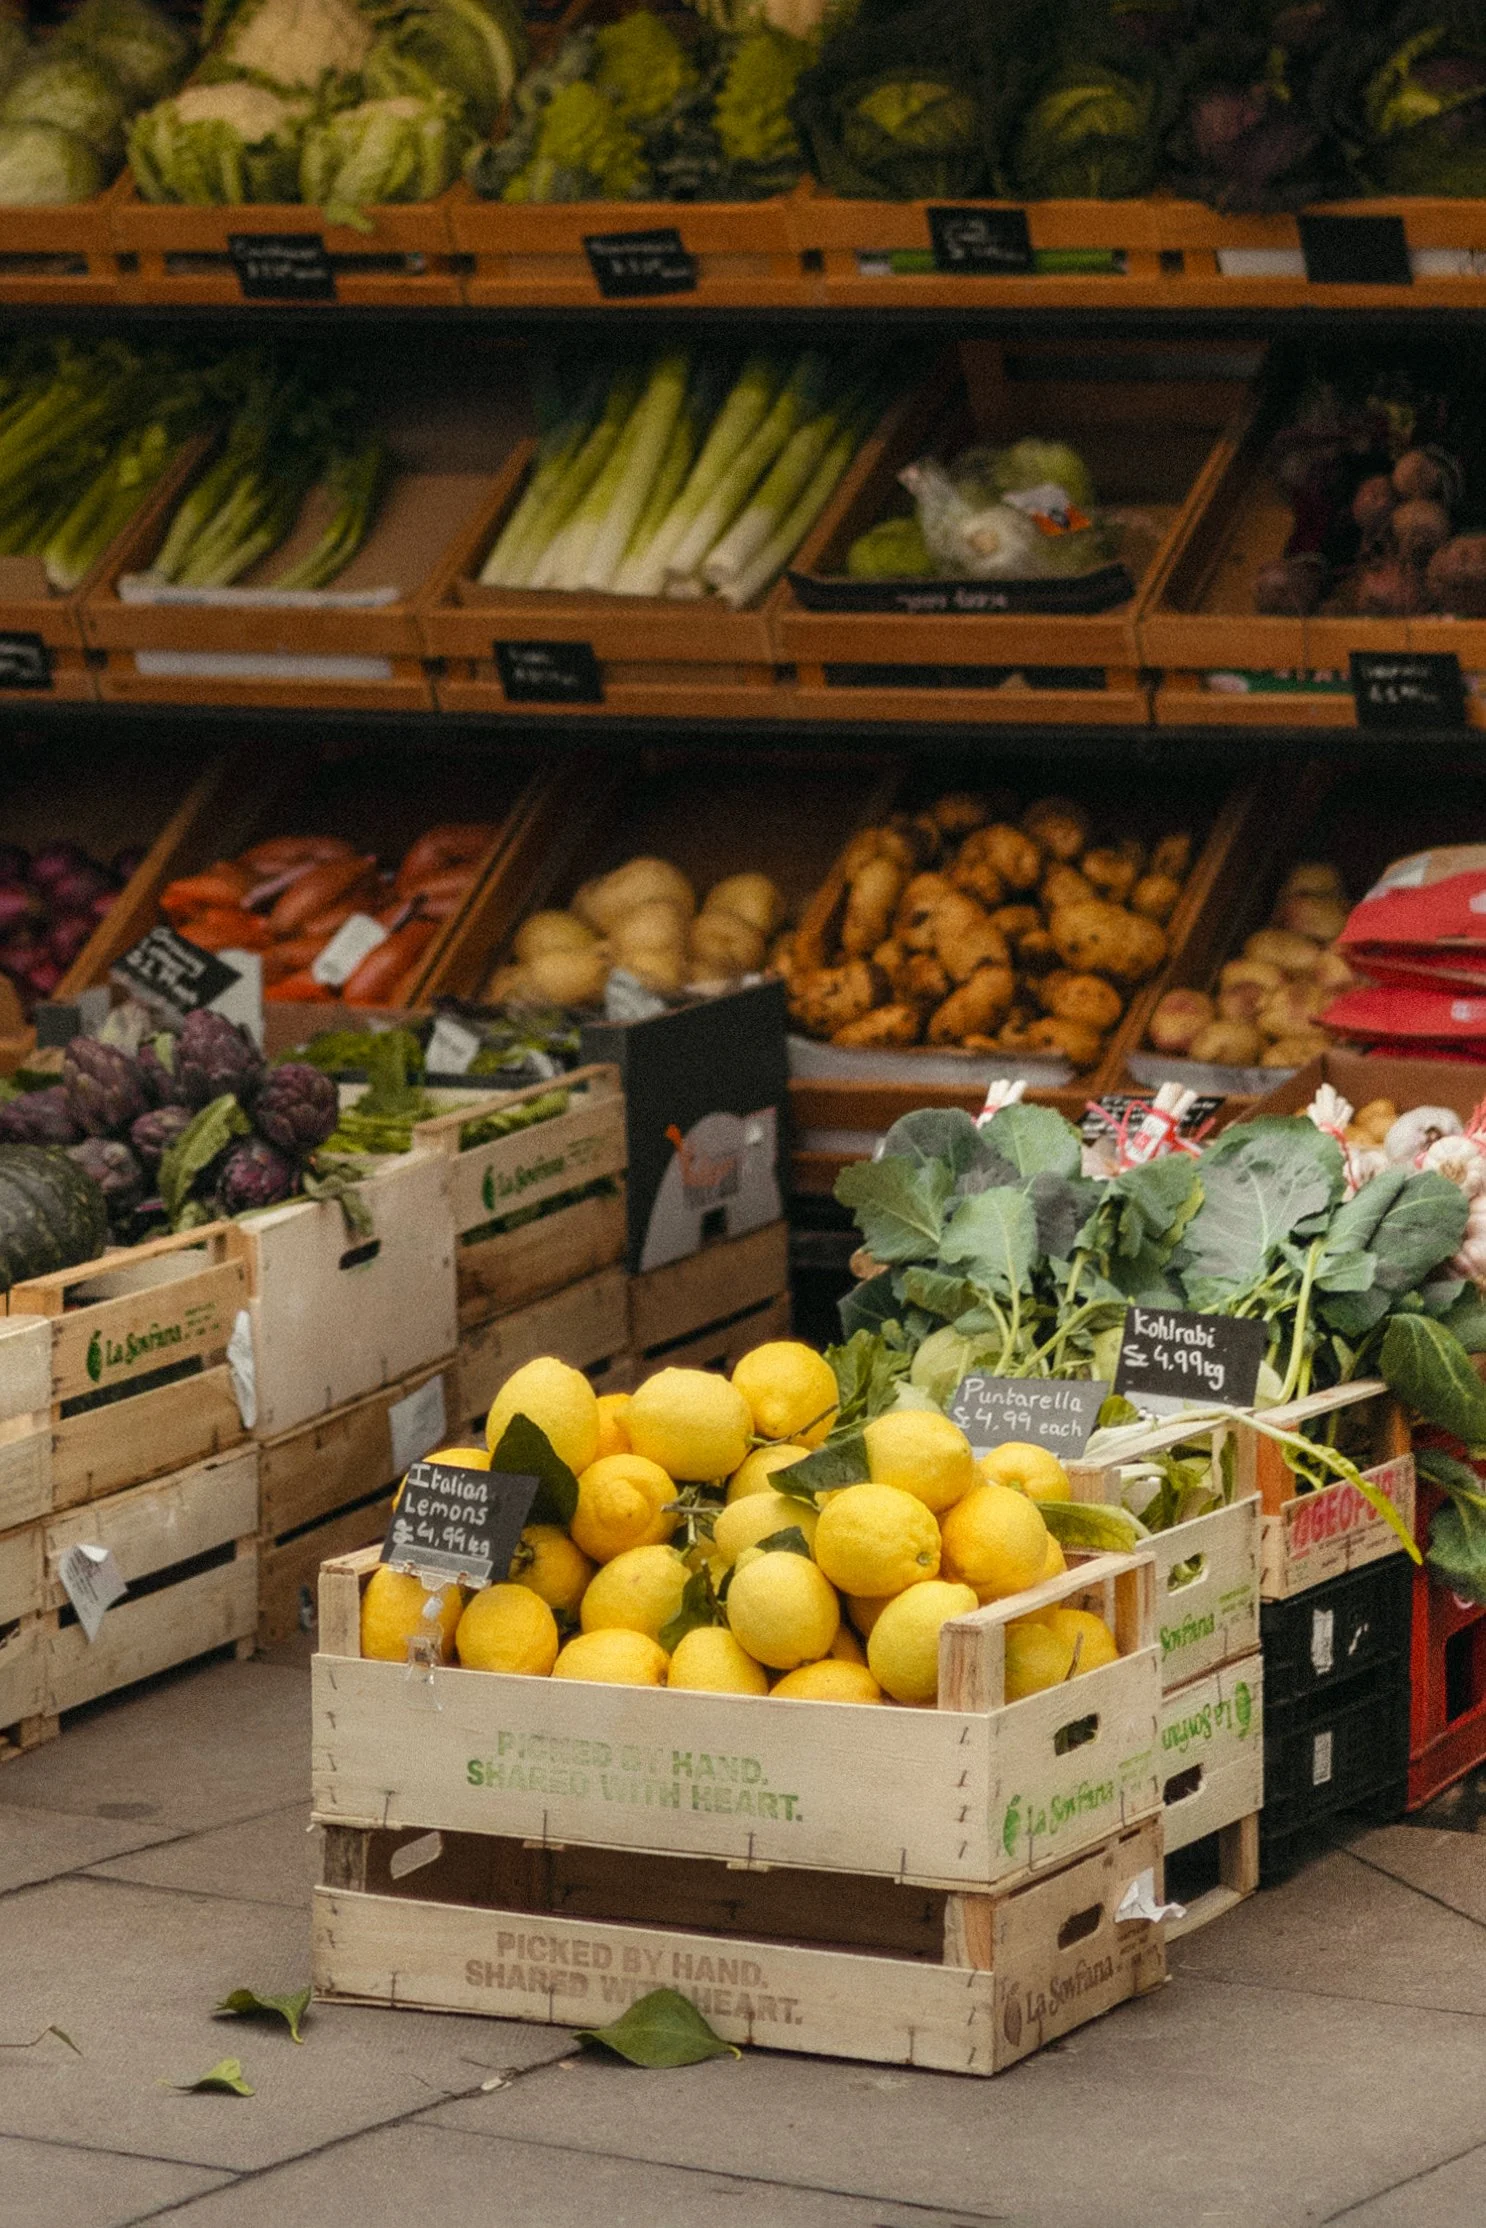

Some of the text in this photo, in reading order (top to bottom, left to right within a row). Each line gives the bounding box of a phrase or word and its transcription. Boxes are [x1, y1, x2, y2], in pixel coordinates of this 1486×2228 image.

[1134, 1308, 1215, 1349] Kohlrabi
[964, 1378, 1083, 1412] Puntarella
[1039, 1420, 1082, 1437] each
[407, 1462, 488, 1502] Italian
[404, 1492, 489, 1526] Lemons
[497, 1931, 613, 1970] PICKED
[622, 1945, 665, 1976] BY
[465, 1959, 590, 1997] SHARED
